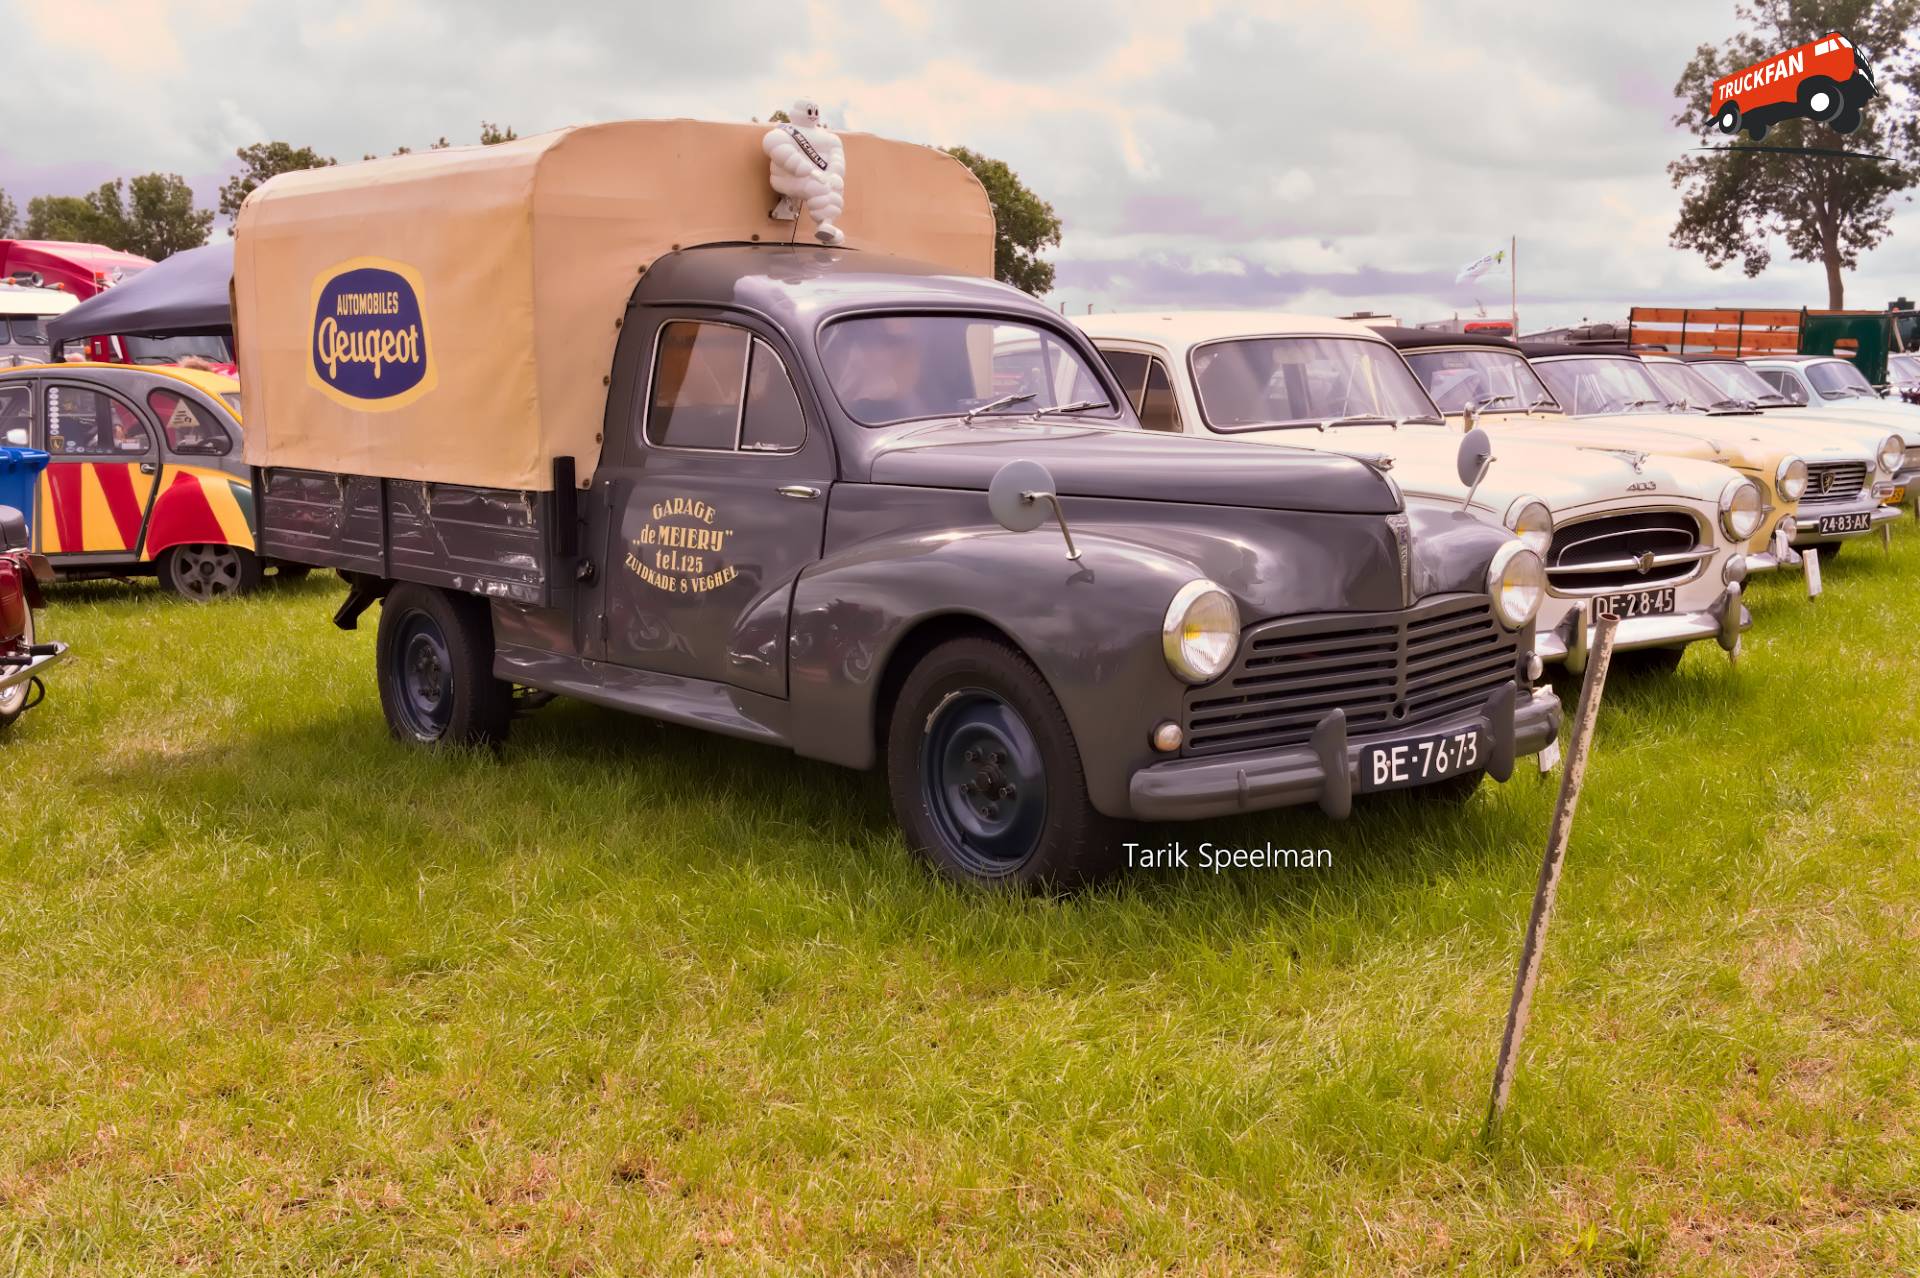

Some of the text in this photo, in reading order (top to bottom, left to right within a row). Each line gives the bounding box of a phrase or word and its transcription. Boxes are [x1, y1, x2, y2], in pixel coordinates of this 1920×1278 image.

[336, 291, 399, 316] AUTOMOBILES
[318, 316, 420, 380] Peugeot
[652, 498, 716, 525] GARAGE
[625, 552, 740, 594] ZUIDKADE 8 VEGHEL
